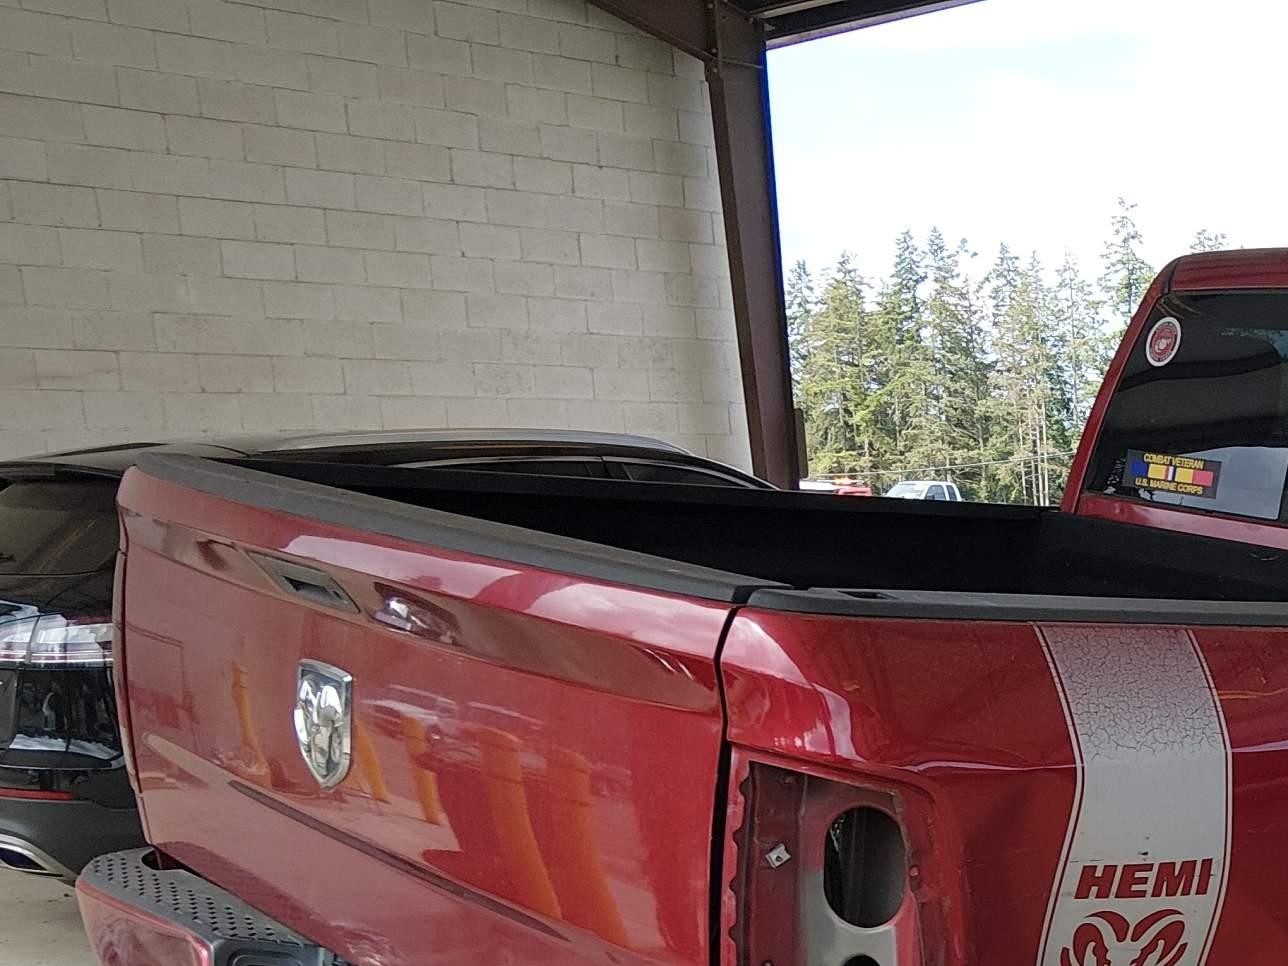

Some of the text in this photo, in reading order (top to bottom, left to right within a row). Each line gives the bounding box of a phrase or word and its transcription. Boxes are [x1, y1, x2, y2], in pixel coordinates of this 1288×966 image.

[1143, 453, 1204, 469] COMBAT VETERAN
[1149, 480, 1177, 491] MARINE
[1177, 483, 1203, 495] CORPS
[1074, 858, 1213, 899] HEMI
